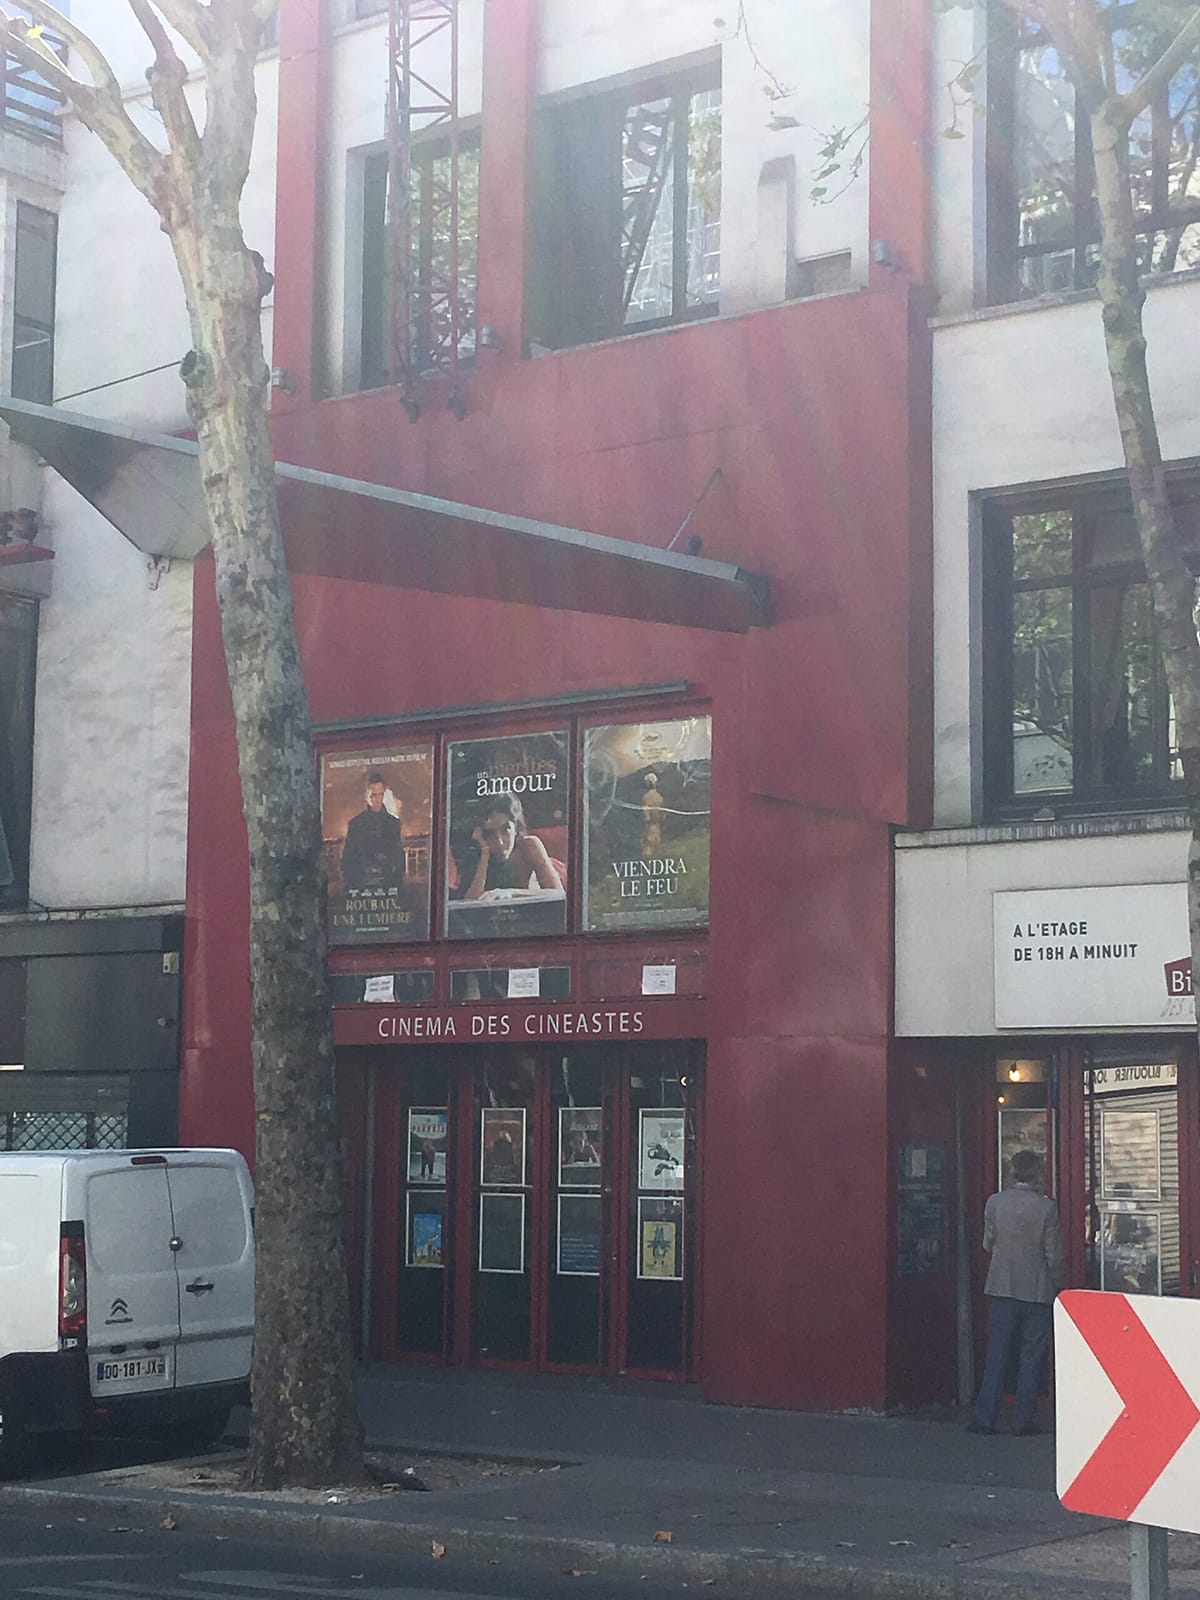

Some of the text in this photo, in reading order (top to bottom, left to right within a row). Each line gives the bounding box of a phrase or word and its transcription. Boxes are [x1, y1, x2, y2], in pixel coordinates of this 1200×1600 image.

[476, 771, 556, 796] amour
[612, 858, 687, 878] VIENDRA
[621, 877, 679, 897] LE FEU
[1013, 921, 1088, 937] A L'ETAGE
[1014, 944, 1138, 961] DE 18H A MINUIT
[378, 1011, 644, 1038] CINEMA DES CINEASTES
